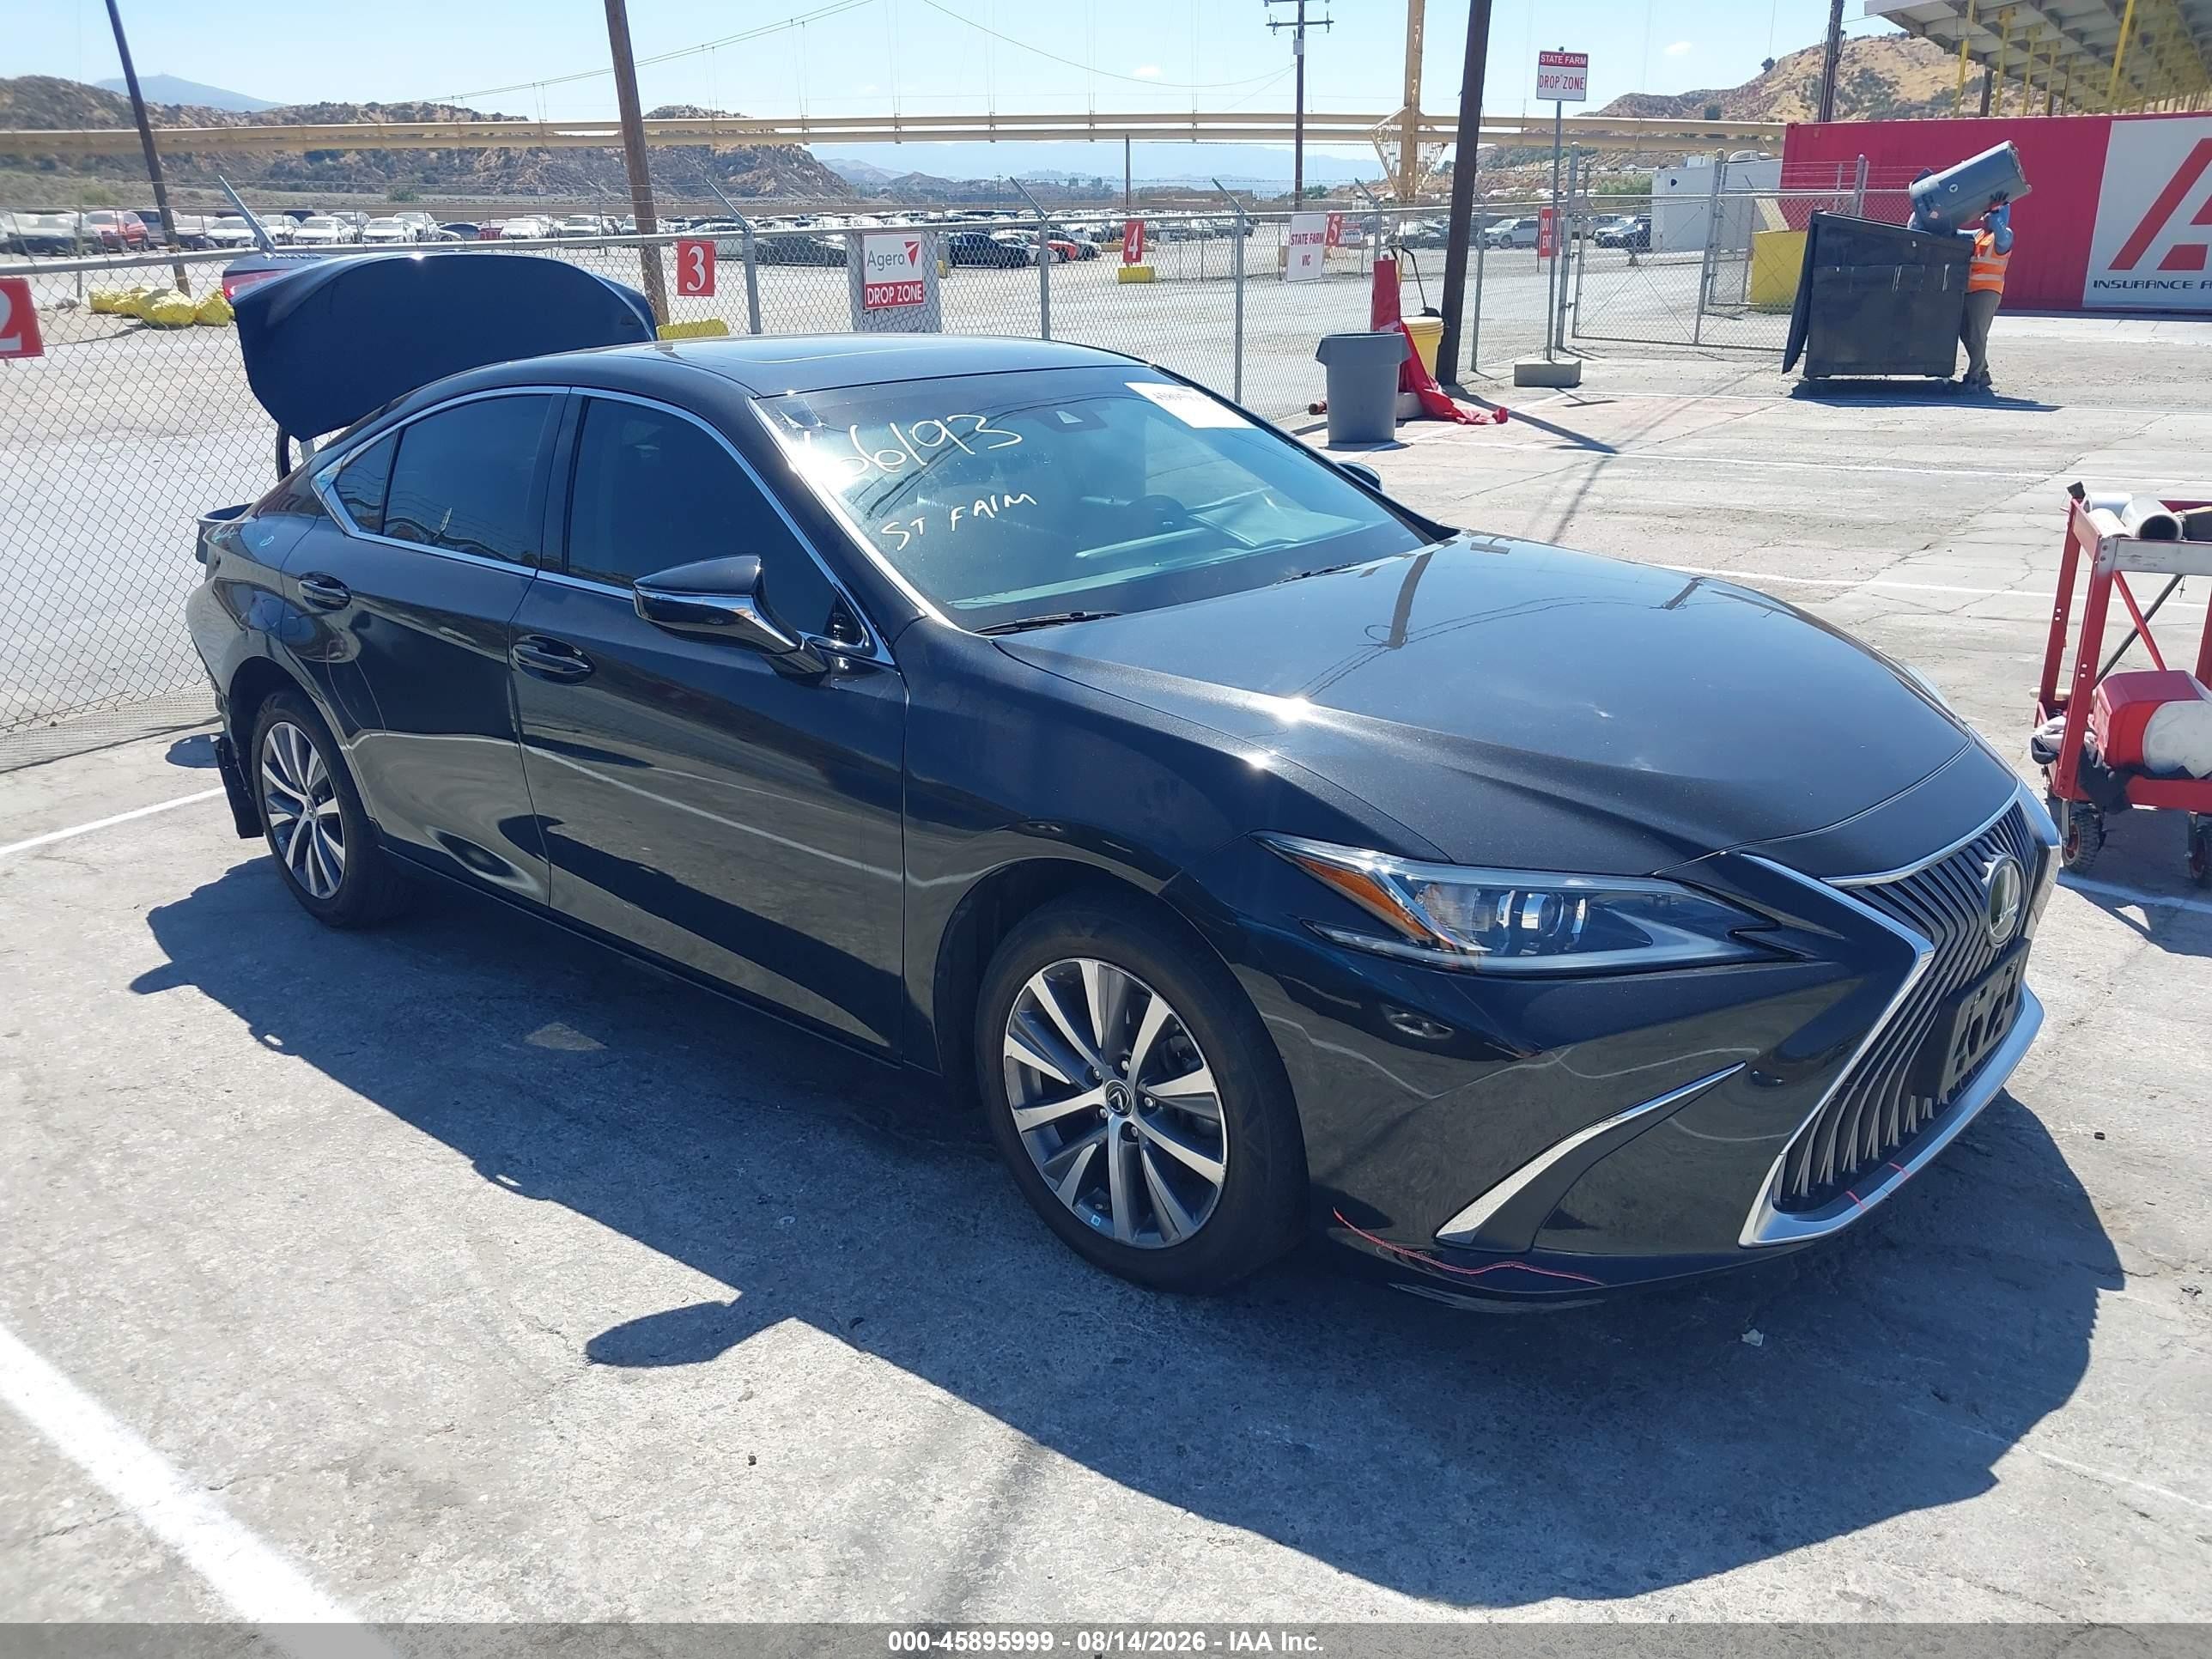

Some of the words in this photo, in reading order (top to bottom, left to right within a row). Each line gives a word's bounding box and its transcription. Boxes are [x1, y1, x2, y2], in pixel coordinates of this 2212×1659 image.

[1540, 54, 1563, 64] STATE
[1565, 56, 1586, 64] FARM
[1539, 75, 1559, 88] DROP
[1563, 76, 1584, 90] ZONE
[1291, 233, 1308, 246] STATE
[1309, 231, 1323, 244] FARM
[1328, 215, 1340, 243] 5
[1127, 224, 1139, 259] 4
[686, 246, 706, 291] 3
[866, 249, 905, 271] Agero
[1302, 254, 1311, 266] VIC
[866, 286, 895, 305] DROP
[896, 283, 923, 302] ZONE
[2093, 279, 2194, 289] INSURANCE
[880, 515, 926, 551] ST
